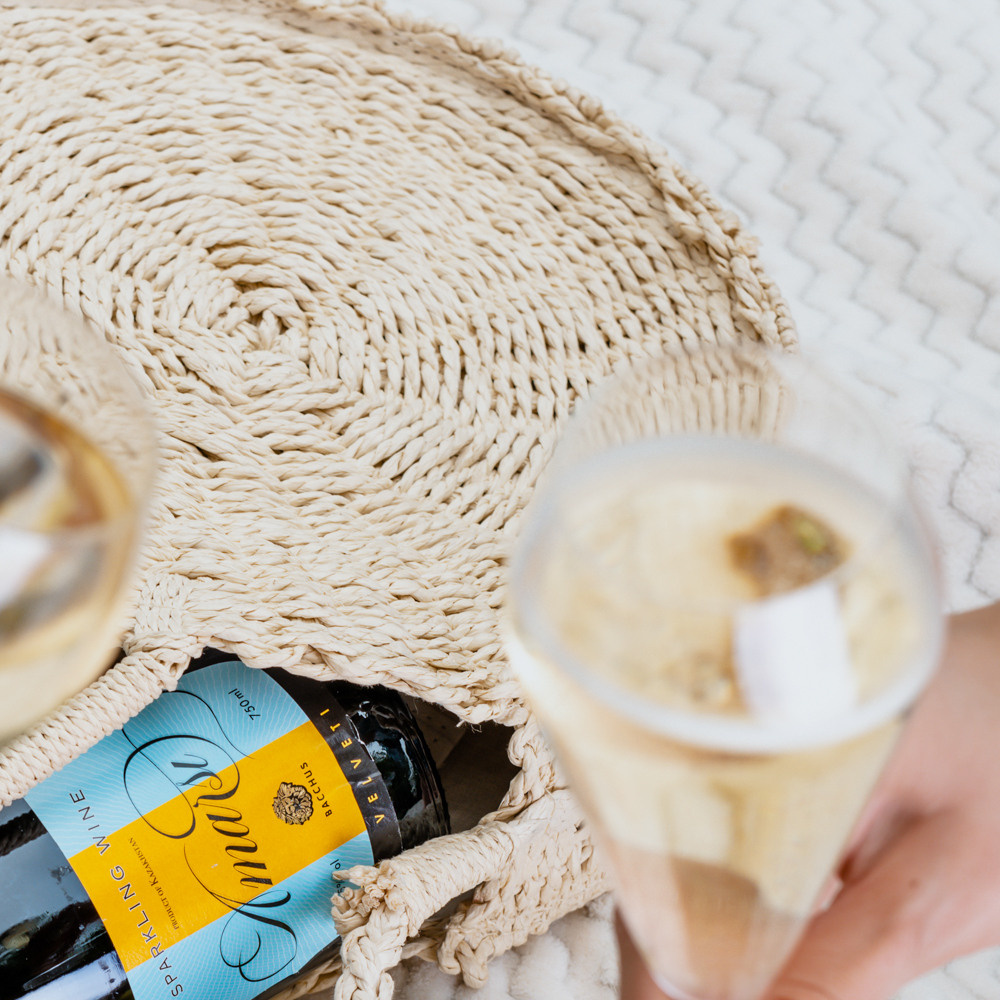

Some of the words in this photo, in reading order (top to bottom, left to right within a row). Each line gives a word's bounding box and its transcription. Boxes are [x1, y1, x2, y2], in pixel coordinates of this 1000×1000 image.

[300, 761, 333, 817] BACCHUS
[69, 788, 111, 855] WINE
[128, 837, 158, 887] KAZAKHSTAN
[110, 864, 183, 997] SPARKLING
[160, 897, 179, 930] PRODUCT
